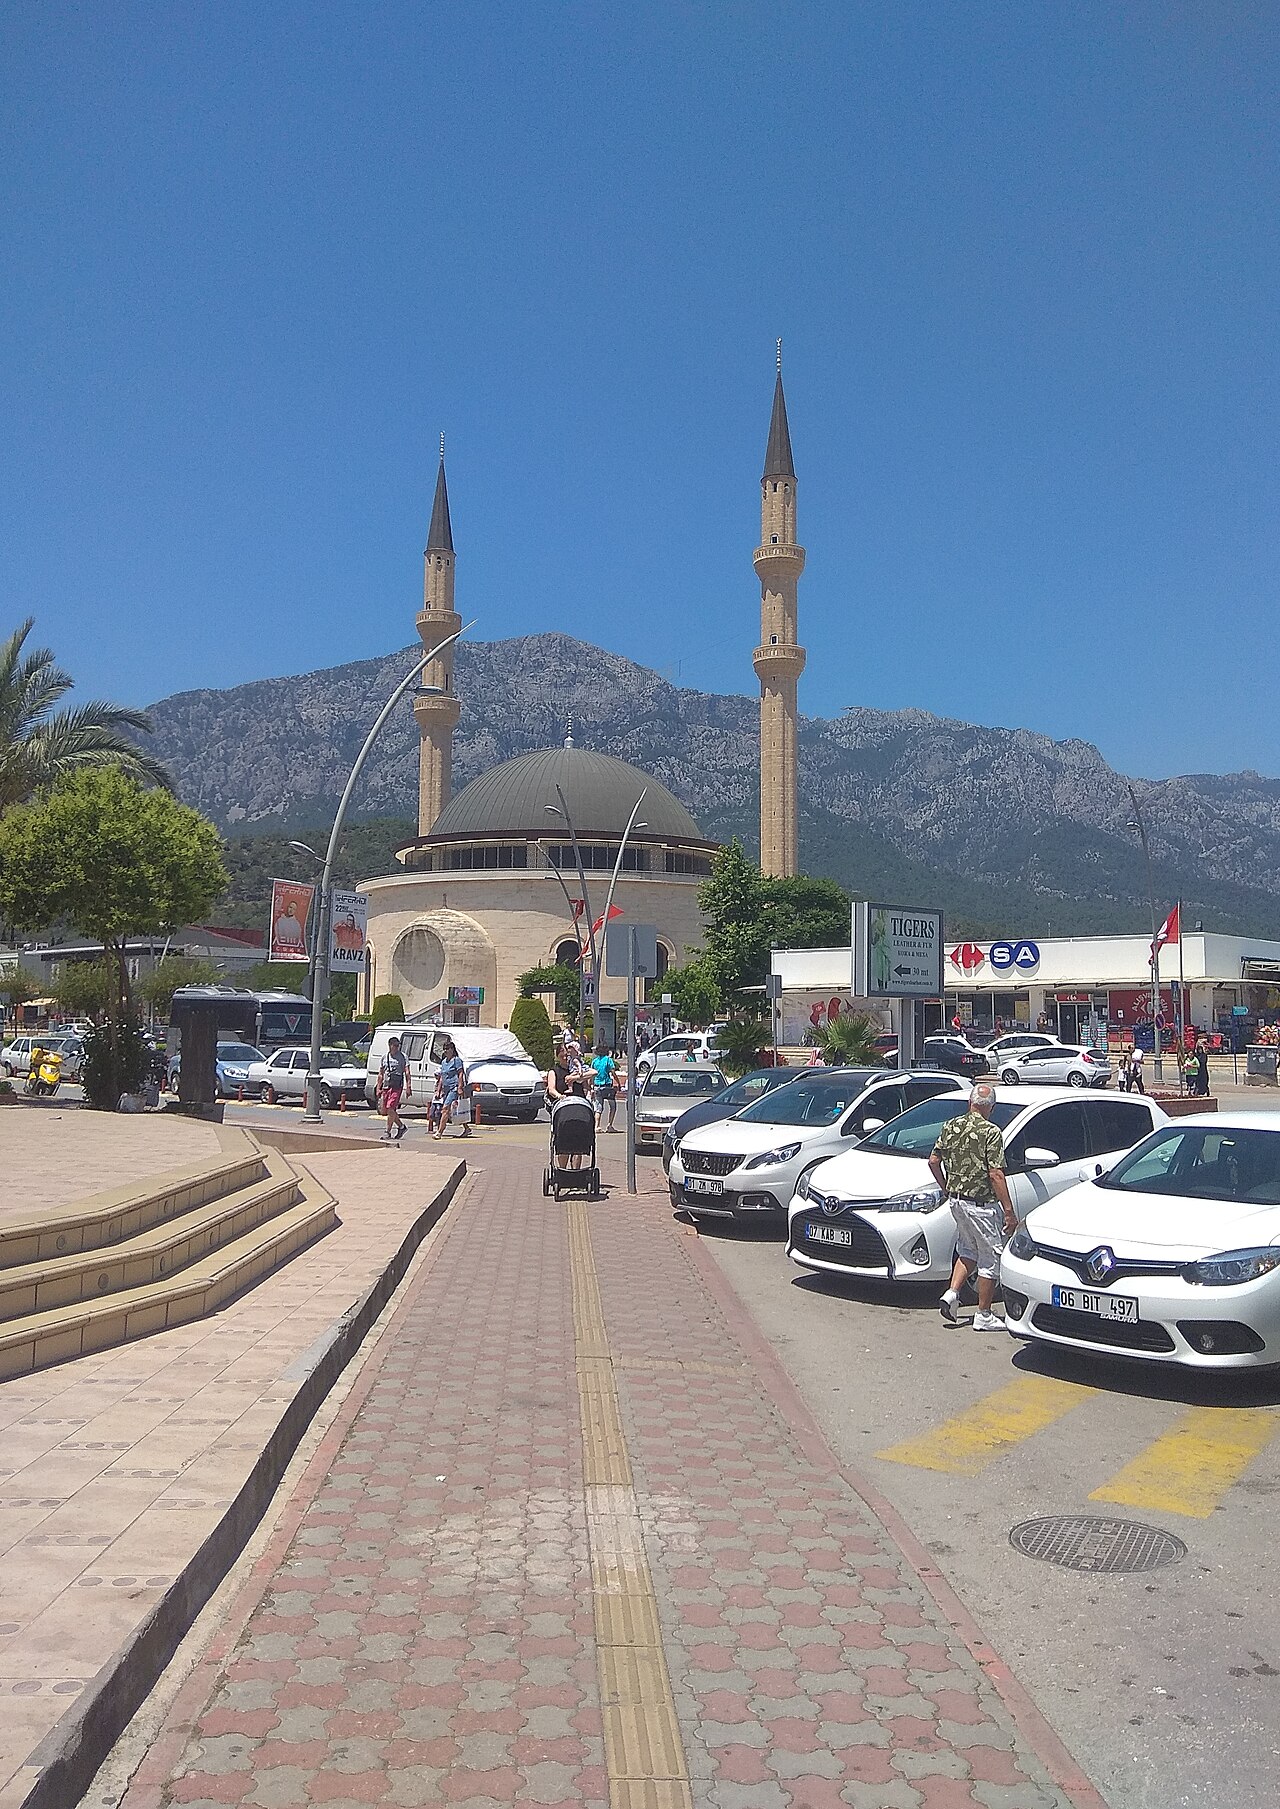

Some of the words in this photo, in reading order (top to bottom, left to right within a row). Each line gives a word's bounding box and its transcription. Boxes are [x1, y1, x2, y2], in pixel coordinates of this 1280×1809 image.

[891, 917, 935, 939] TIGERS
[893, 940, 917, 949] LEATHER
[333, 948, 364, 962] KRAVZ
[711, 1181, 722, 1192] 978
[810, 1225, 818, 1238] 07
[821, 1227, 835, 1241] KAB
[840, 1231, 850, 1244] 33
[1060, 1290, 1075, 1307] 06
[1082, 1294, 1101, 1312] BIT
[1110, 1298, 1134, 1317] 497
